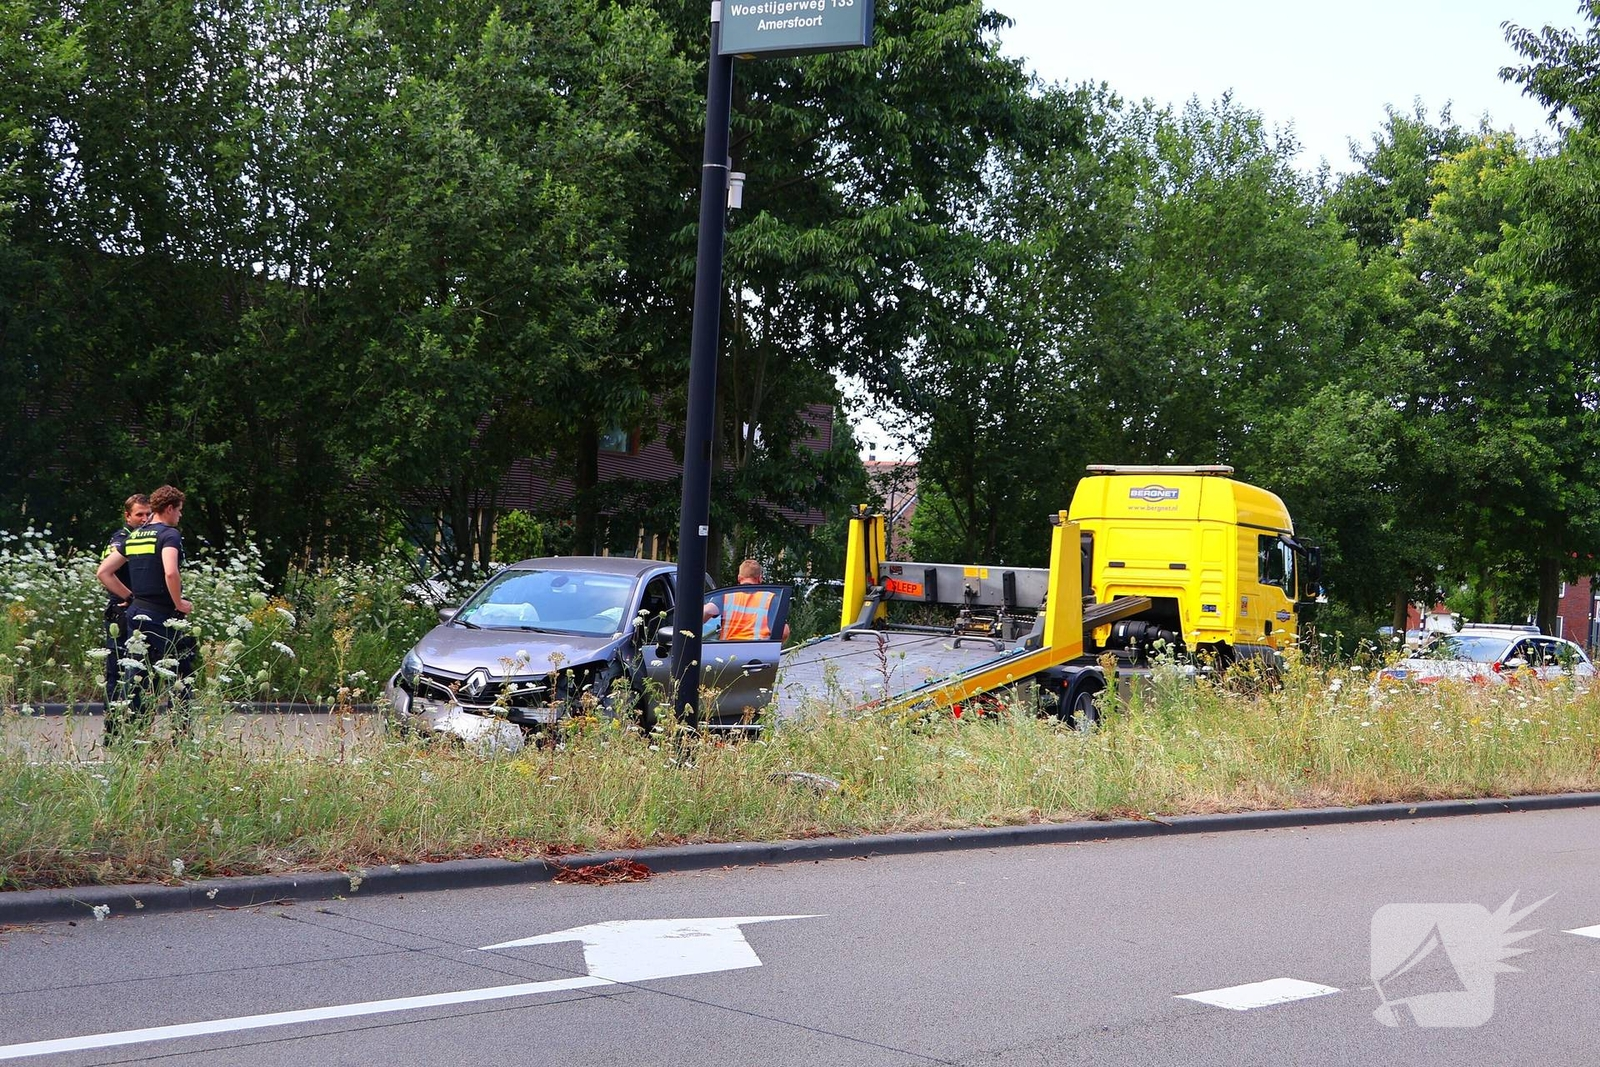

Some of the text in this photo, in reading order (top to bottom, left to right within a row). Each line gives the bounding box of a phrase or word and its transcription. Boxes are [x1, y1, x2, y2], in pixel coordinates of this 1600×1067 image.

[731, 0, 826, 16] Woestijgerweg
[757, 15, 823, 31] Amersfoort
[1130, 489, 1178, 497] BERGNET
[892, 580, 917, 594] SLEEP
